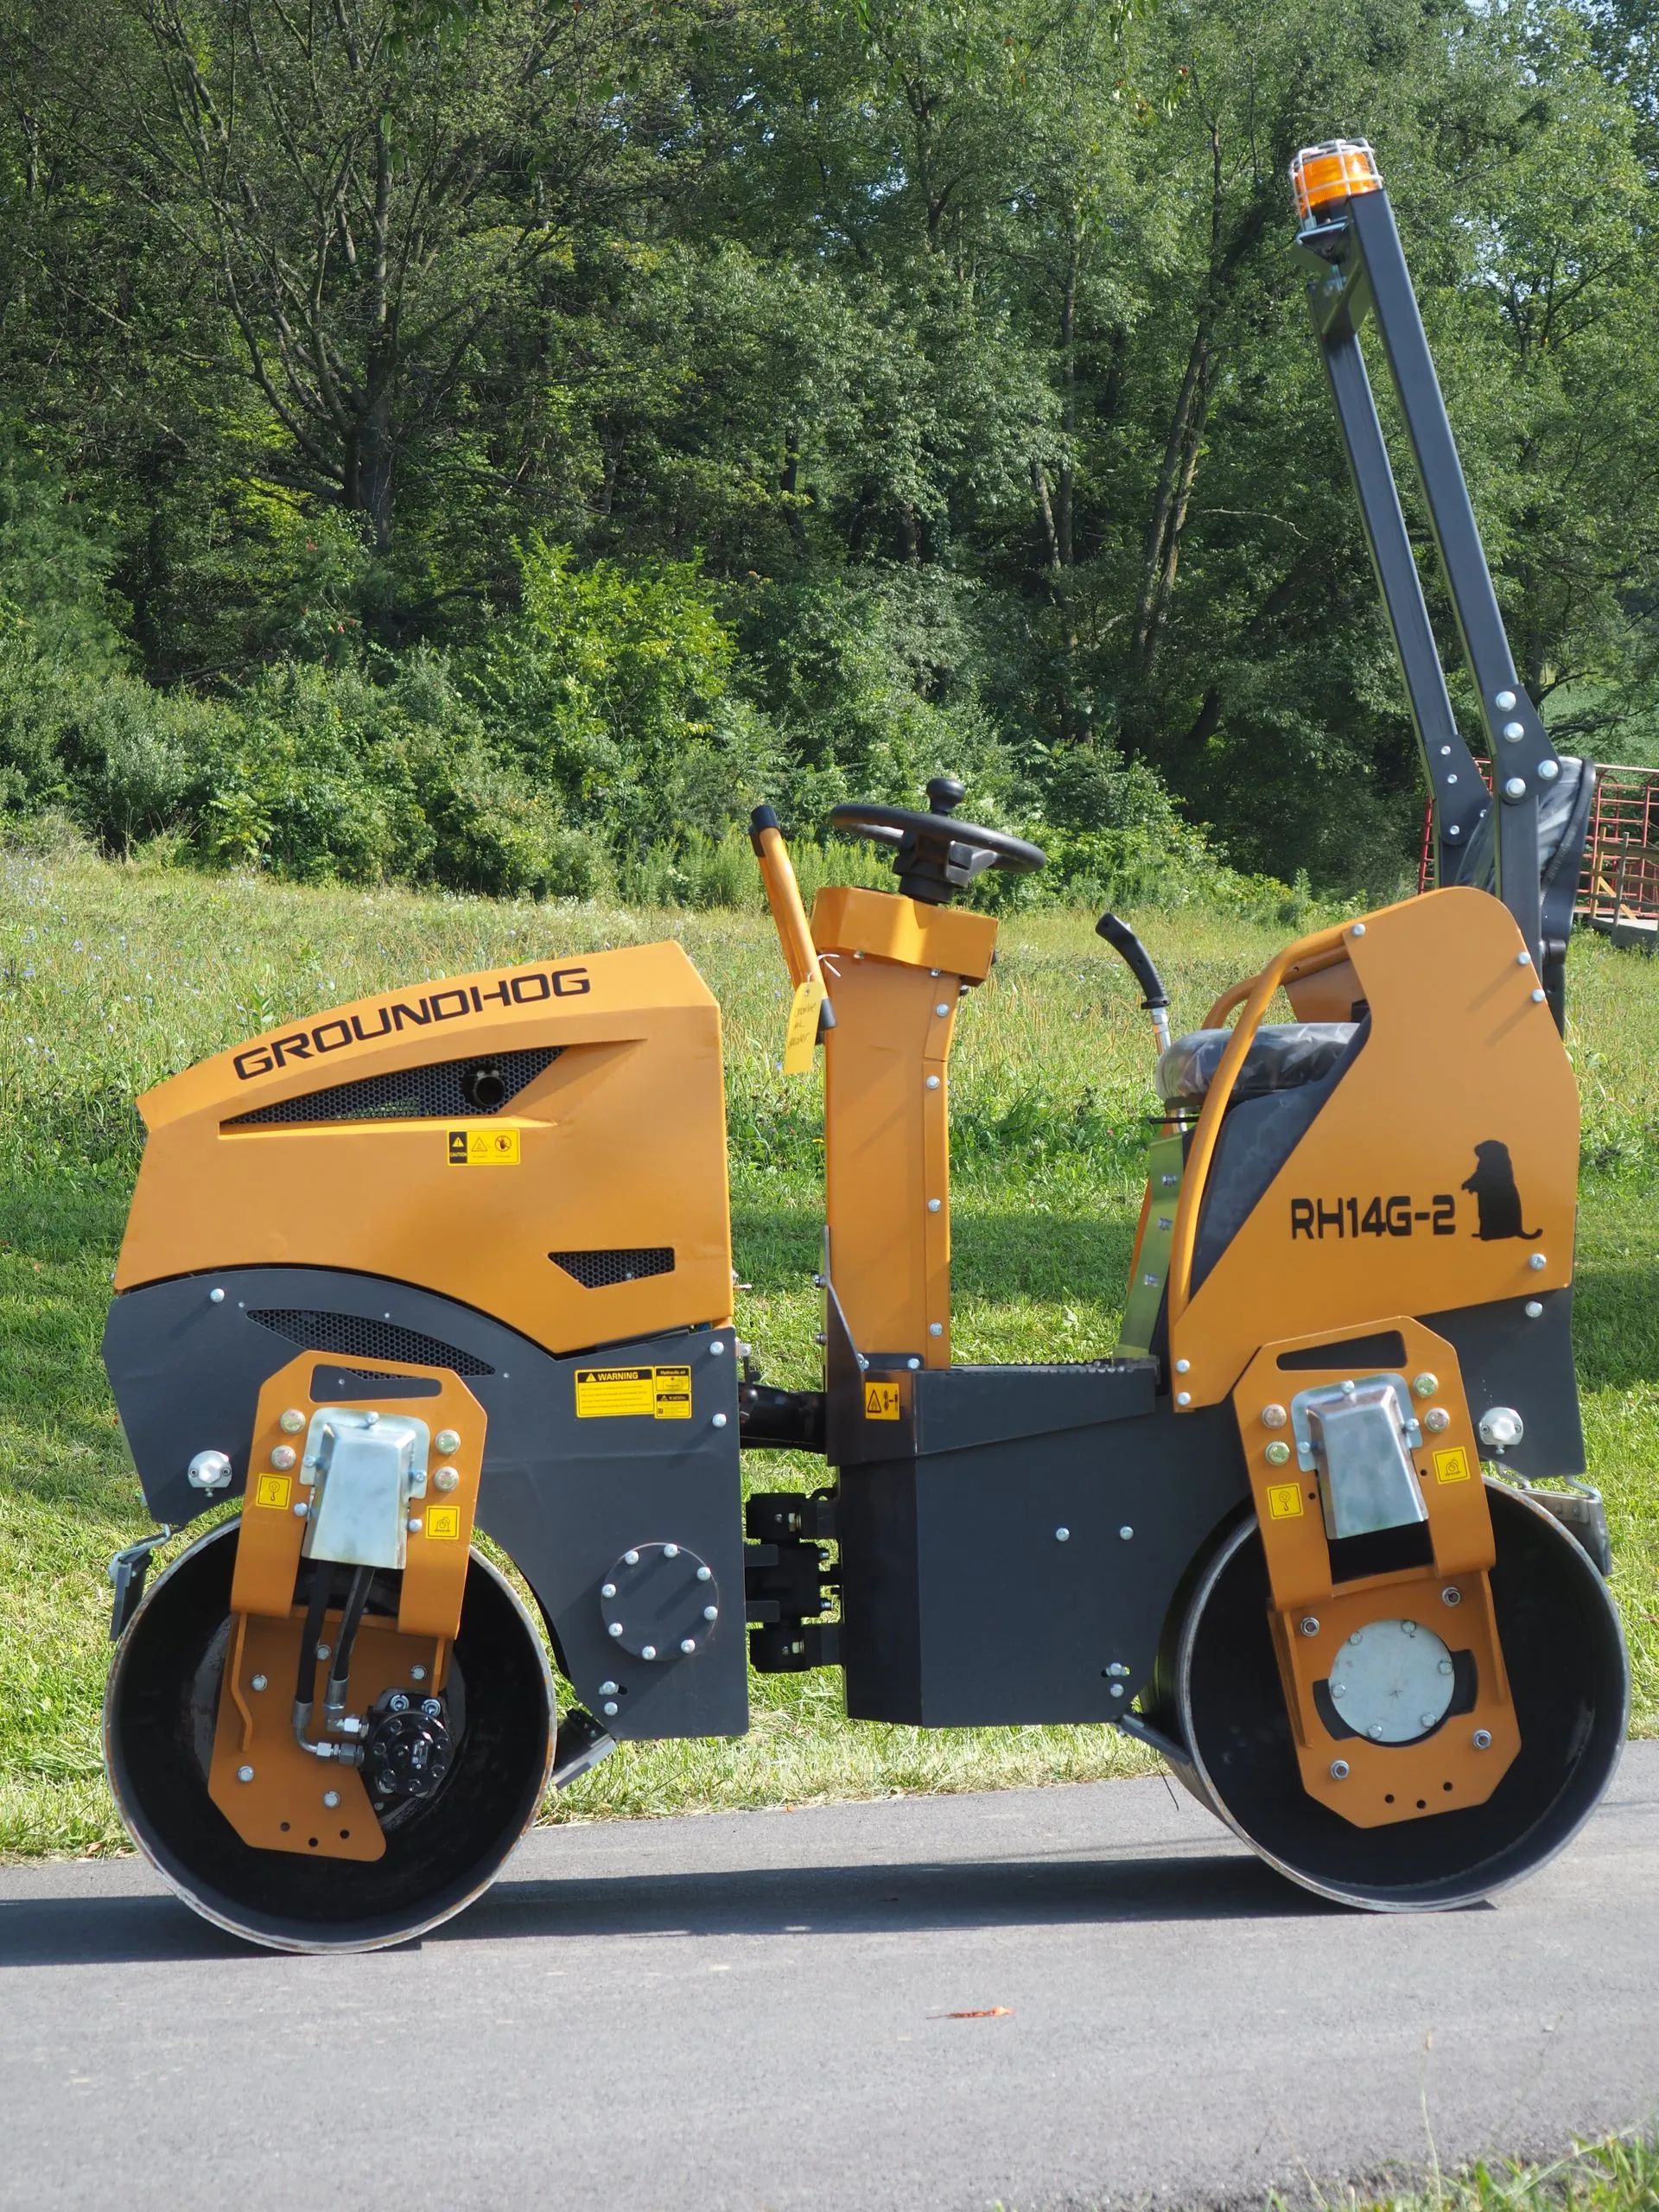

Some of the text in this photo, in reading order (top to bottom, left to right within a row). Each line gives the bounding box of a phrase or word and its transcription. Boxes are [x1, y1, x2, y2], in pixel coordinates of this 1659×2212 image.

[232, 967, 591, 1081] GROUNDHOG
[1291, 1194, 1457, 1239] RH14G-2
[597, 1371, 639, 1382] WARNING
